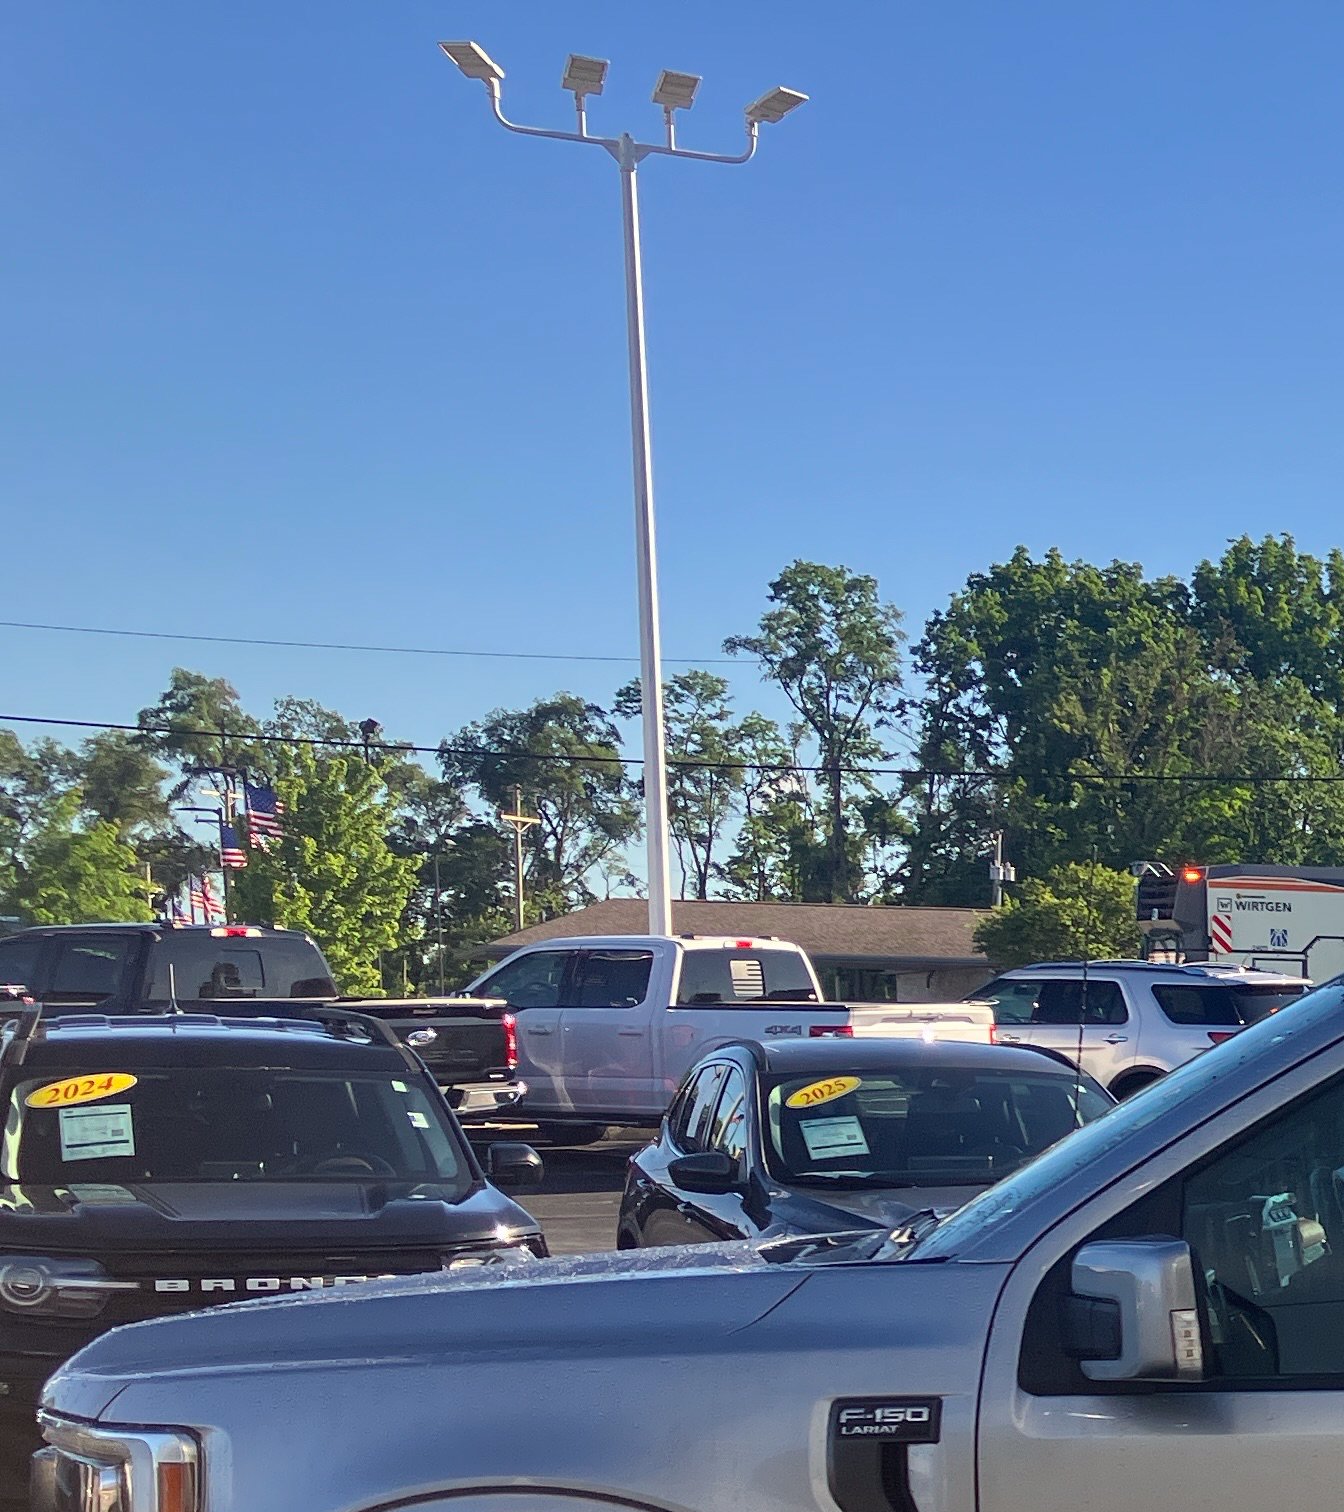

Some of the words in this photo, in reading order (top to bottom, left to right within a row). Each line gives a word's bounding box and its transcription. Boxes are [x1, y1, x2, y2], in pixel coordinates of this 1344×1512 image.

[1235, 900, 1292, 912] WIRTGEN
[44, 1076, 114, 1104] 2024
[800, 1079, 847, 1105] 2025
[154, 1274, 396, 1293] BRON
[840, 1406, 930, 1423] F-150
[841, 1424, 900, 1436] LARIAT
